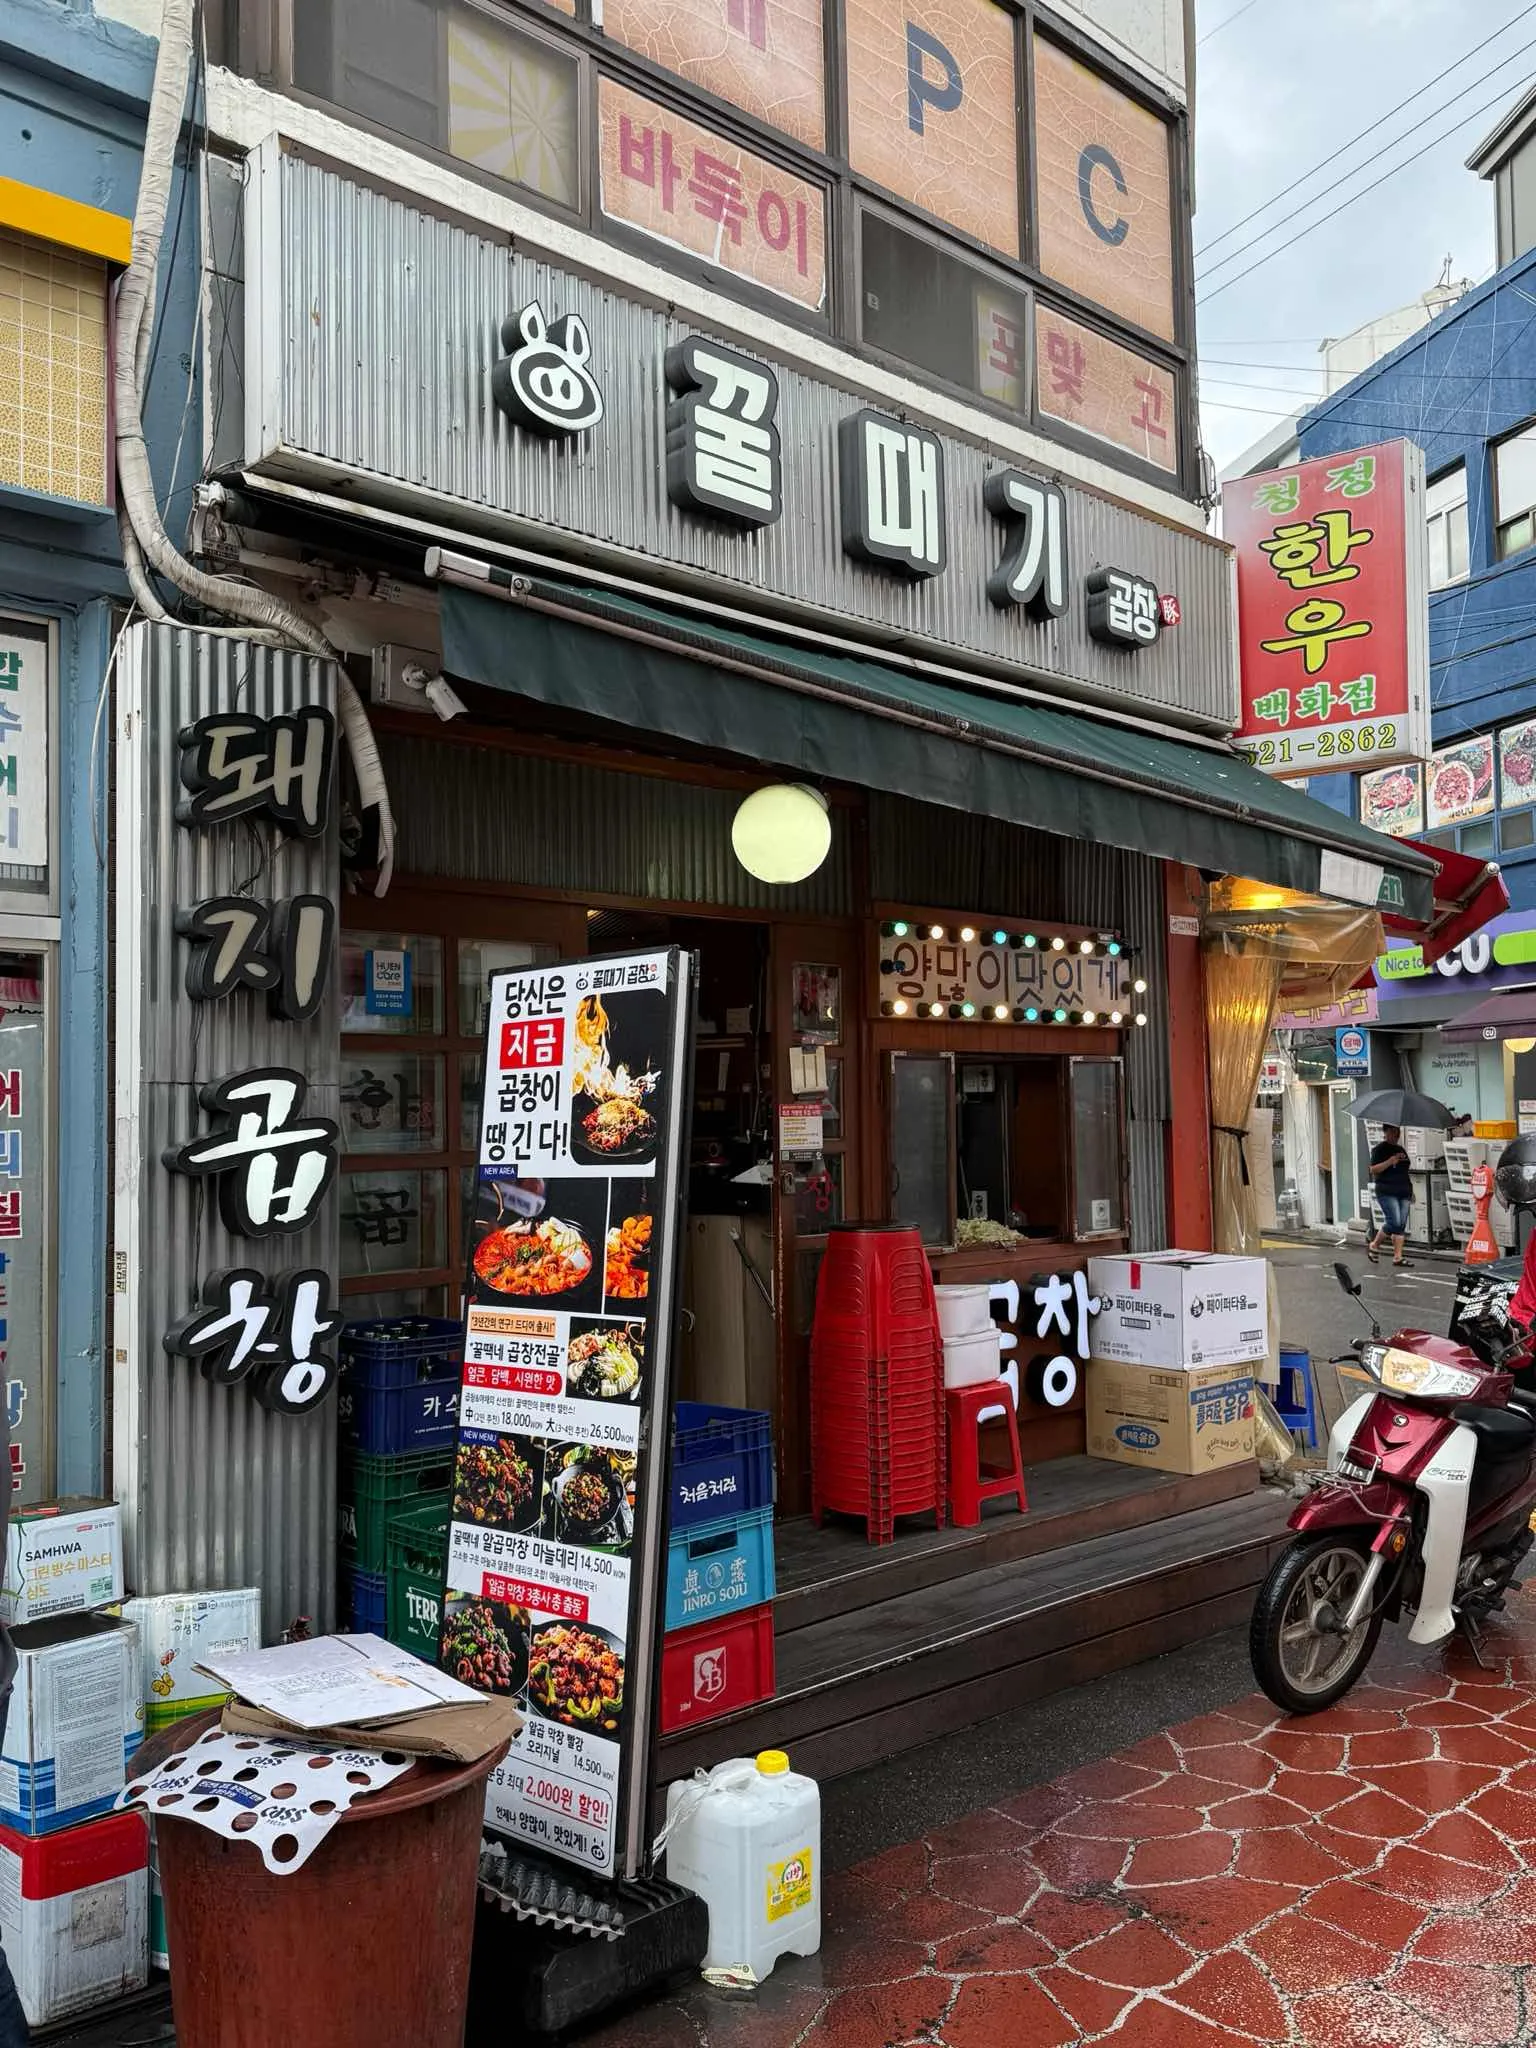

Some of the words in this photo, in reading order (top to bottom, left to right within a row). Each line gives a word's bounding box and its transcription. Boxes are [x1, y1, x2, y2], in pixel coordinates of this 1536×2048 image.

[619, 115, 809, 277] 바둑이
[1110, 575, 1156, 639] 곱창
[1259, 509, 1374, 674] 한우
[1253, 674, 1377, 728] 백화점
[1386, 957, 1409, 972] Nice
[1437, 934, 1491, 977] CU
[592, 966, 625, 989] 꿀때기
[627, 963, 654, 985] 곱창
[505, 975, 567, 1019] 당신은
[507, 1024, 557, 1065] 지금
[498, 1071, 560, 1113] 곱창이
[485, 1167, 499, 1176] NEW
[500, 1167, 515, 1175] AREA
[1116, 1298, 1162, 1317] 페이퍼타올
[1207, 1295, 1247, 1313] 페이퍼타올
[515, 1371, 543, 1389] 시원한
[546, 1375, 555, 1391] 맛
[464, 1431, 478, 1439] NEW
[480, 1433, 497, 1442] MENU
[546, 1417, 555, 1433] 大
[680, 1476, 737, 1503] 처음처럼
[26, 1542, 82, 1561] SAMHWA
[483, 1533, 529, 1559] 알곱막창
[533, 1543, 578, 1571] 마늘데리
[580, 1554, 612, 1575] 14,500
[406, 1590, 439, 1625] TERR
[507, 1583, 526, 1602] 막창
[682, 1591, 716, 1615] JINRO
[719, 1582, 748, 1604] SOJU
[528, 1721, 545, 1739] 알곱
[547, 1727, 565, 1746] 막창
[566, 1733, 584, 1752] 빨강
[526, 1740, 560, 1764] 오리지널
[573, 1755, 602, 1776] 14,500
[507, 1773, 524, 1793] 최대
[526, 1776, 574, 1812] 2,000원
[578, 1793, 609, 1825] 할인!
[496, 1806, 517, 1825] 언제나
[553, 1825, 588, 1853] 맛있게!
